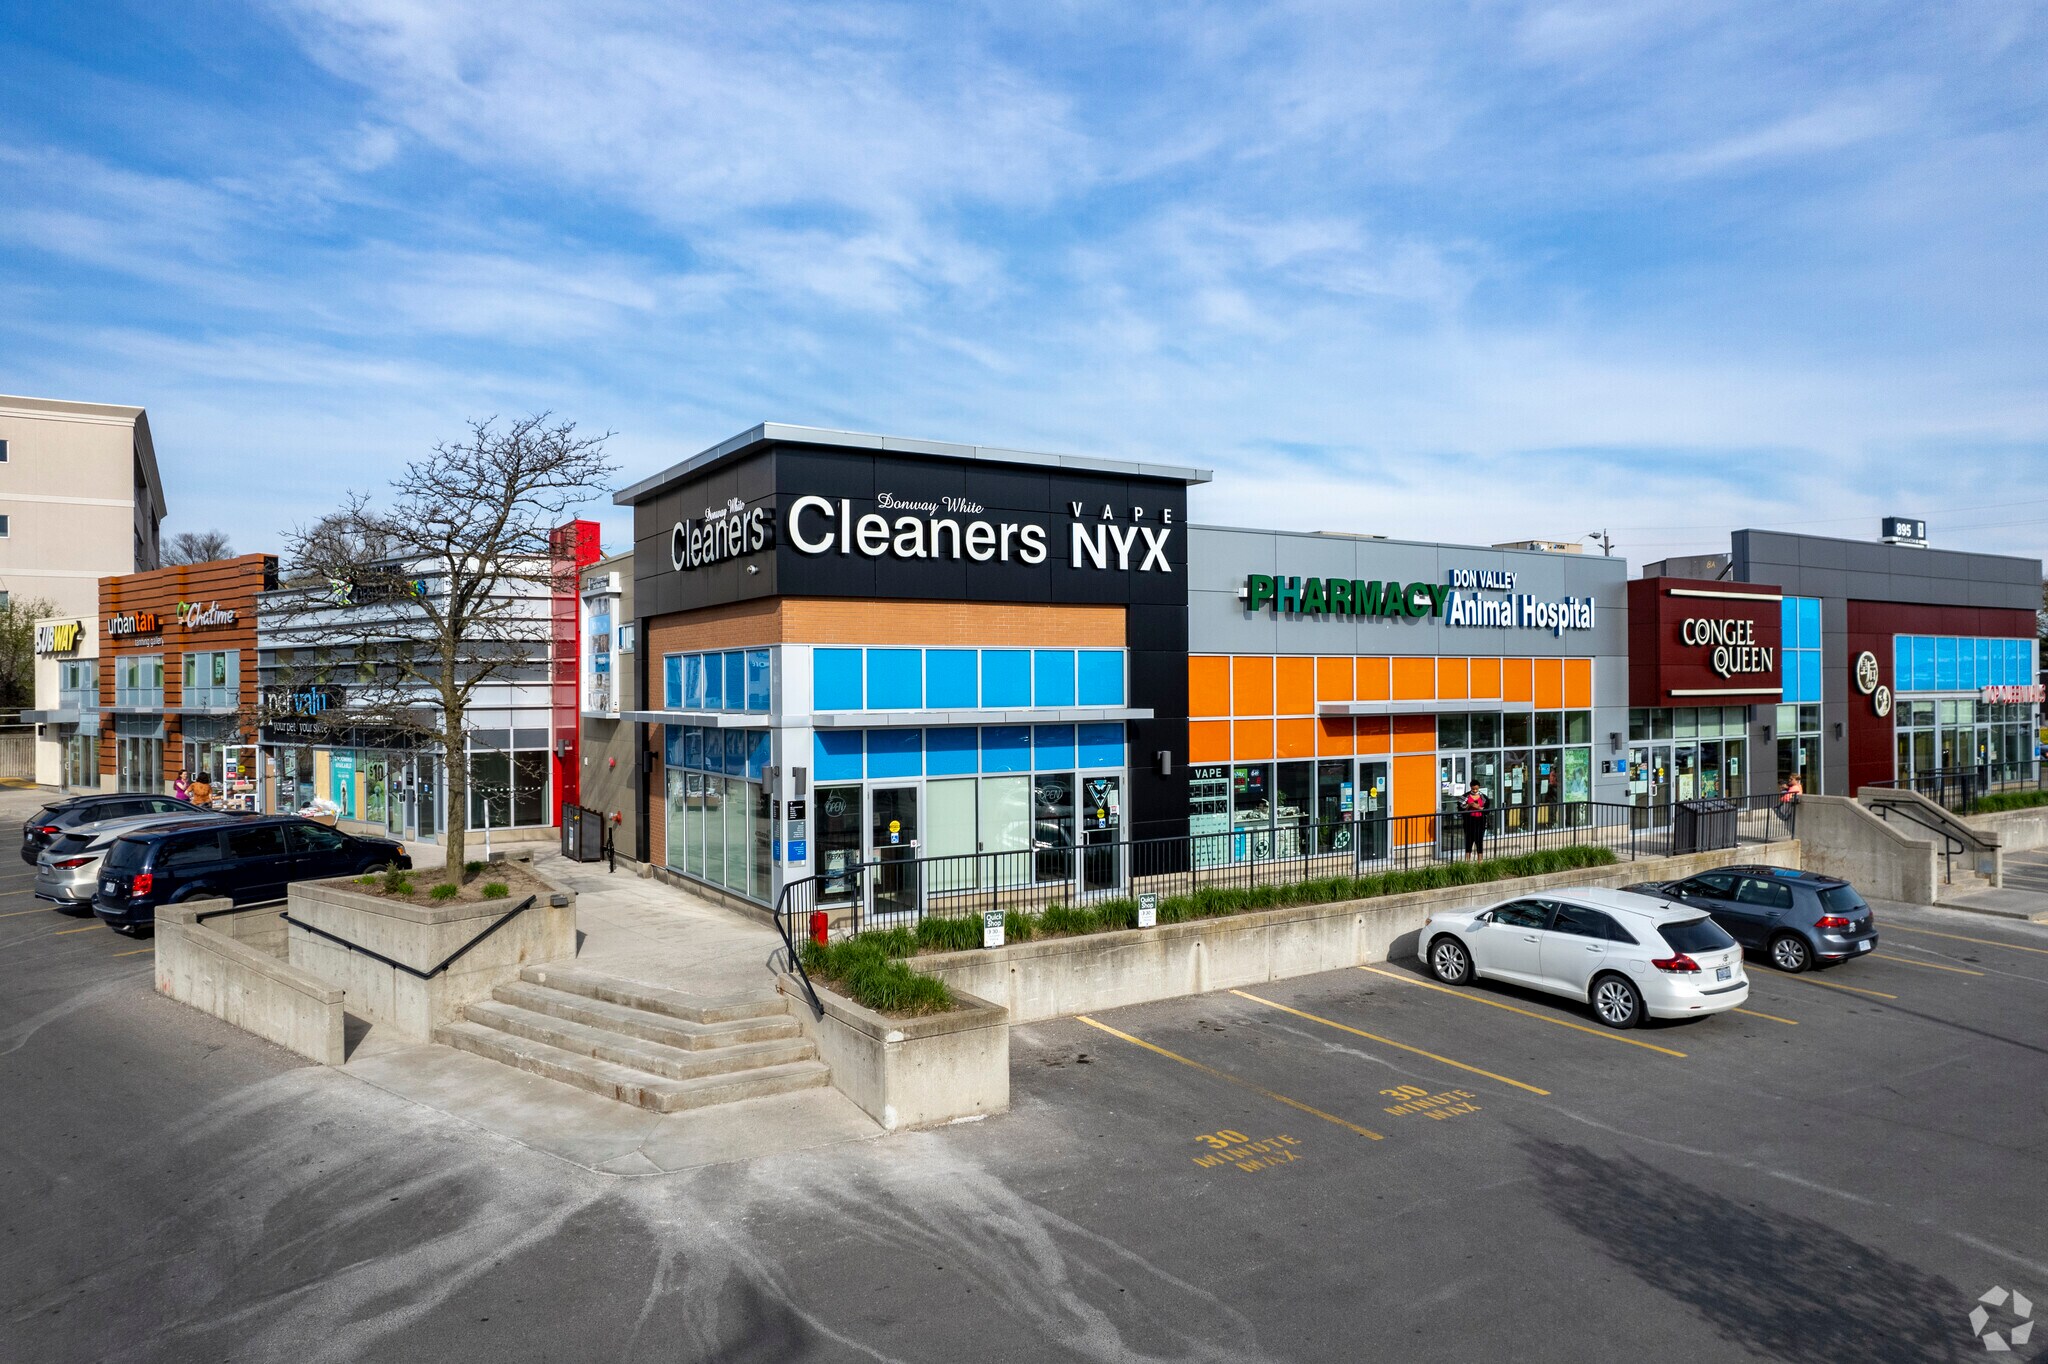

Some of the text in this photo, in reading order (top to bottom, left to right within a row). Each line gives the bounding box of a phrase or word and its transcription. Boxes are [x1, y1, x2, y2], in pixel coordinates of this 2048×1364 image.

[878, 492, 984, 516] Donway White
[1072, 501, 1172, 524] VAPE
[671, 507, 764, 571] Cleaners
[788, 495, 1047, 564] Cleaners
[1896, 522, 1912, 537] 895
[1071, 522, 1172, 572] NYX
[1453, 569, 1517, 589] DON VALLEY
[1249, 574, 1450, 618] PHARMACY
[187, 601, 235, 628] Chatime
[1450, 591, 1595, 636] Animal Hospital
[36, 624, 78, 653] SUBWAY
[1683, 618, 1755, 646] CONGEE
[1713, 646, 1773, 678] QUEEN
[370, 764, 384, 781] $10
[1195, 768, 1222, 778] VAPE
[986, 913, 1003, 921] Quick
[987, 920, 1001, 928] Shop
[1379, 1085, 1428, 1101] 30
[1383, 1089, 1476, 1116] MINUTE
[1423, 1101, 1482, 1120] MAX
[1192, 1134, 1302, 1168] MINUTE
[1195, 1129, 1249, 1149] 30
[1236, 1149, 1304, 1172] MAX
